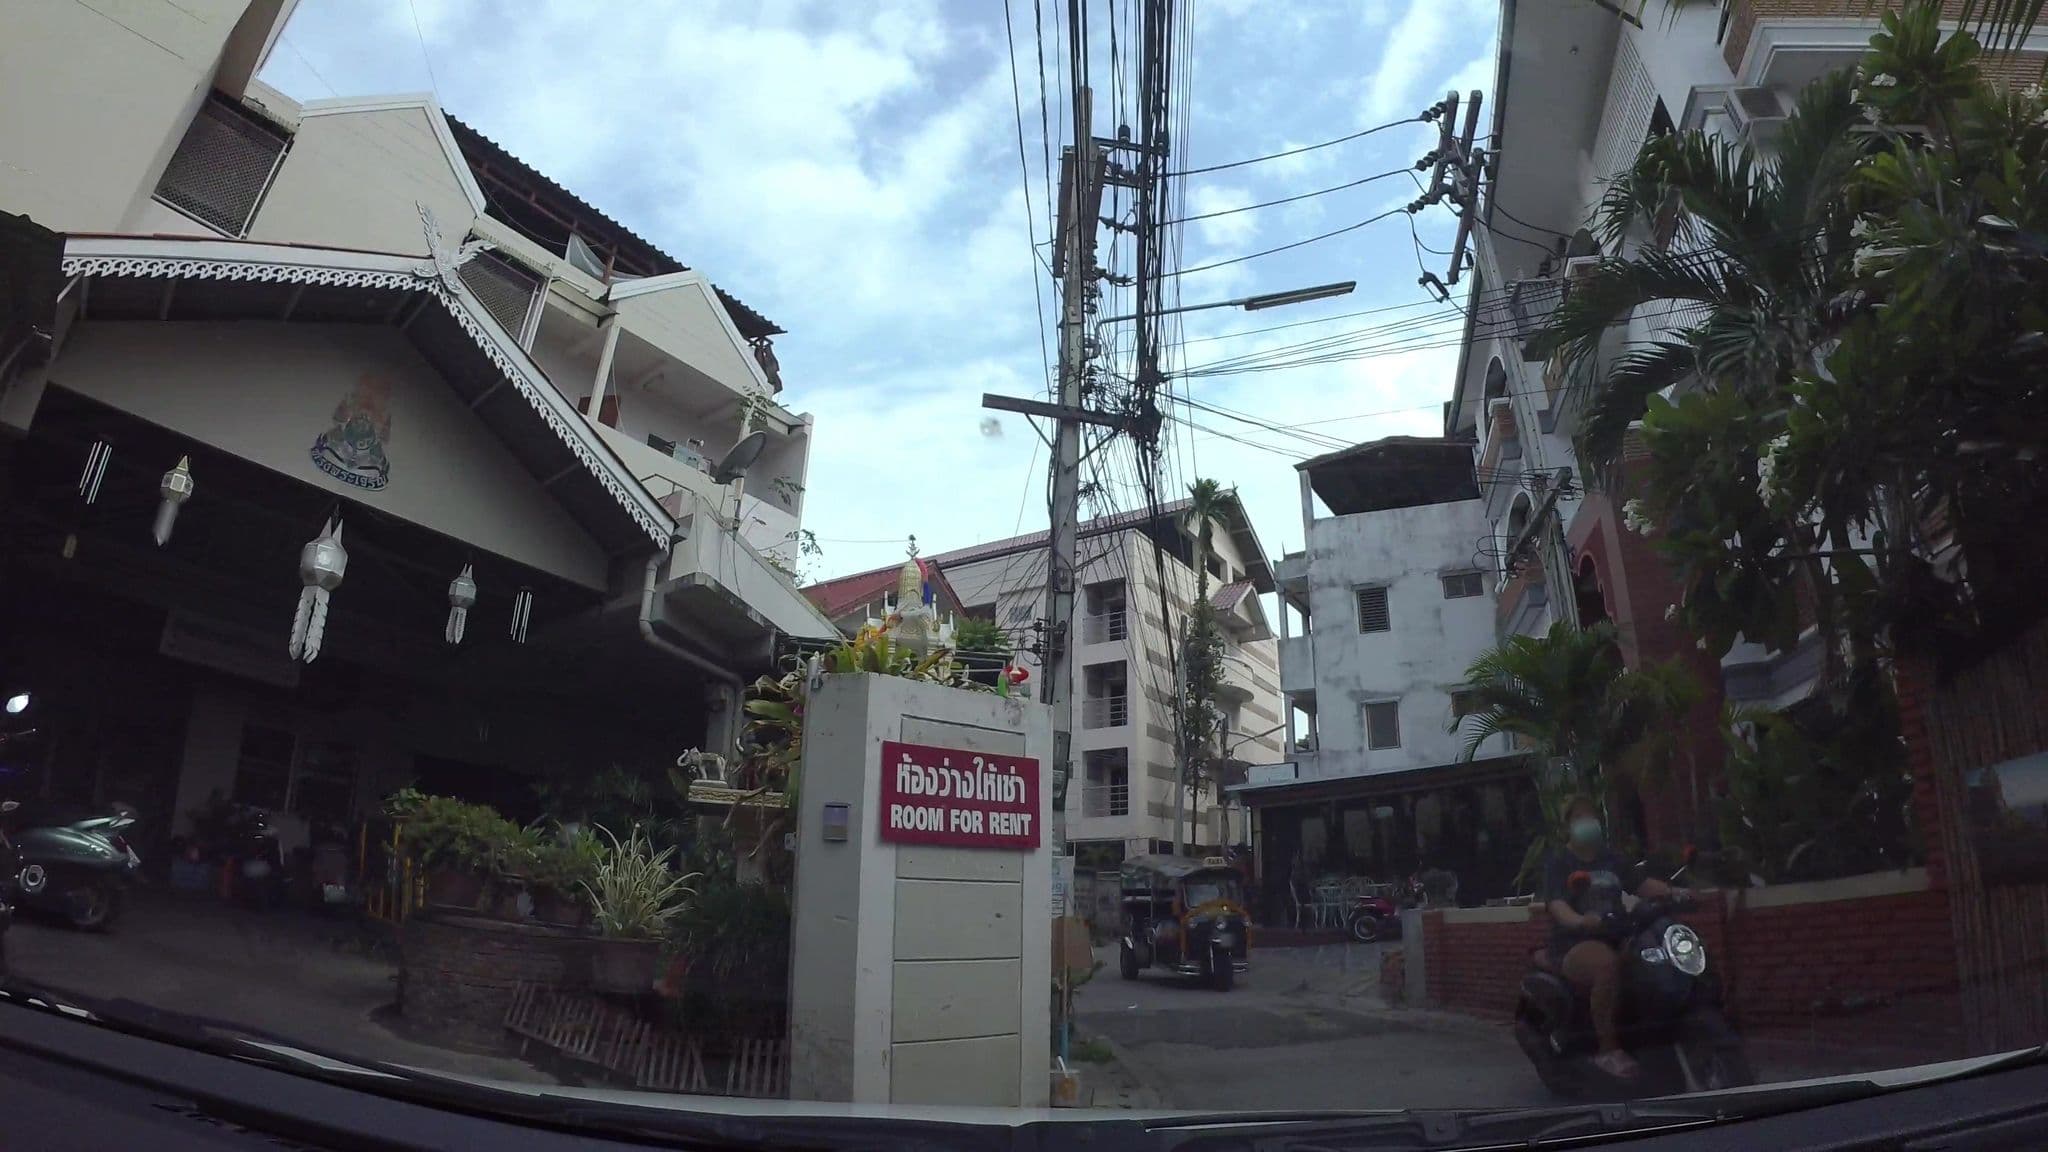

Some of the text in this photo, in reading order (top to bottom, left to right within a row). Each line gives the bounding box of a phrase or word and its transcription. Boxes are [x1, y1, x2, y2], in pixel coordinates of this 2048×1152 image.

[896, 753, 1026, 804] ห้องว่างให้เช่า
[890, 804, 1032, 836] ROOM FOR RENT
